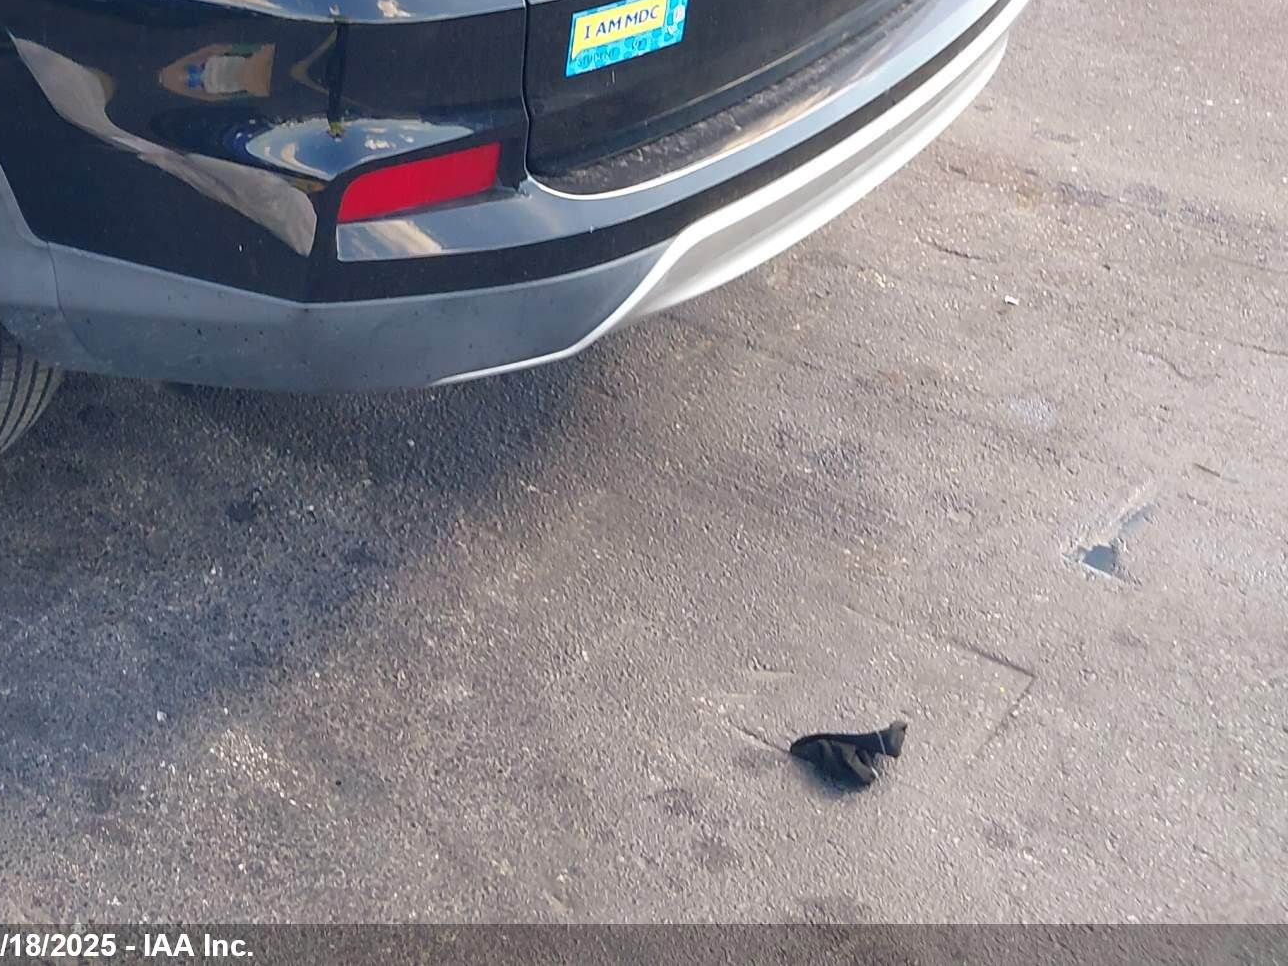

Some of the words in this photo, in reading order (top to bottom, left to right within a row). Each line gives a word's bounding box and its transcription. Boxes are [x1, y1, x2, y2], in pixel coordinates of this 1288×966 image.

[584, 25, 591, 40] I
[595, 17, 622, 37] AM
[625, 5, 660, 28] MDC
